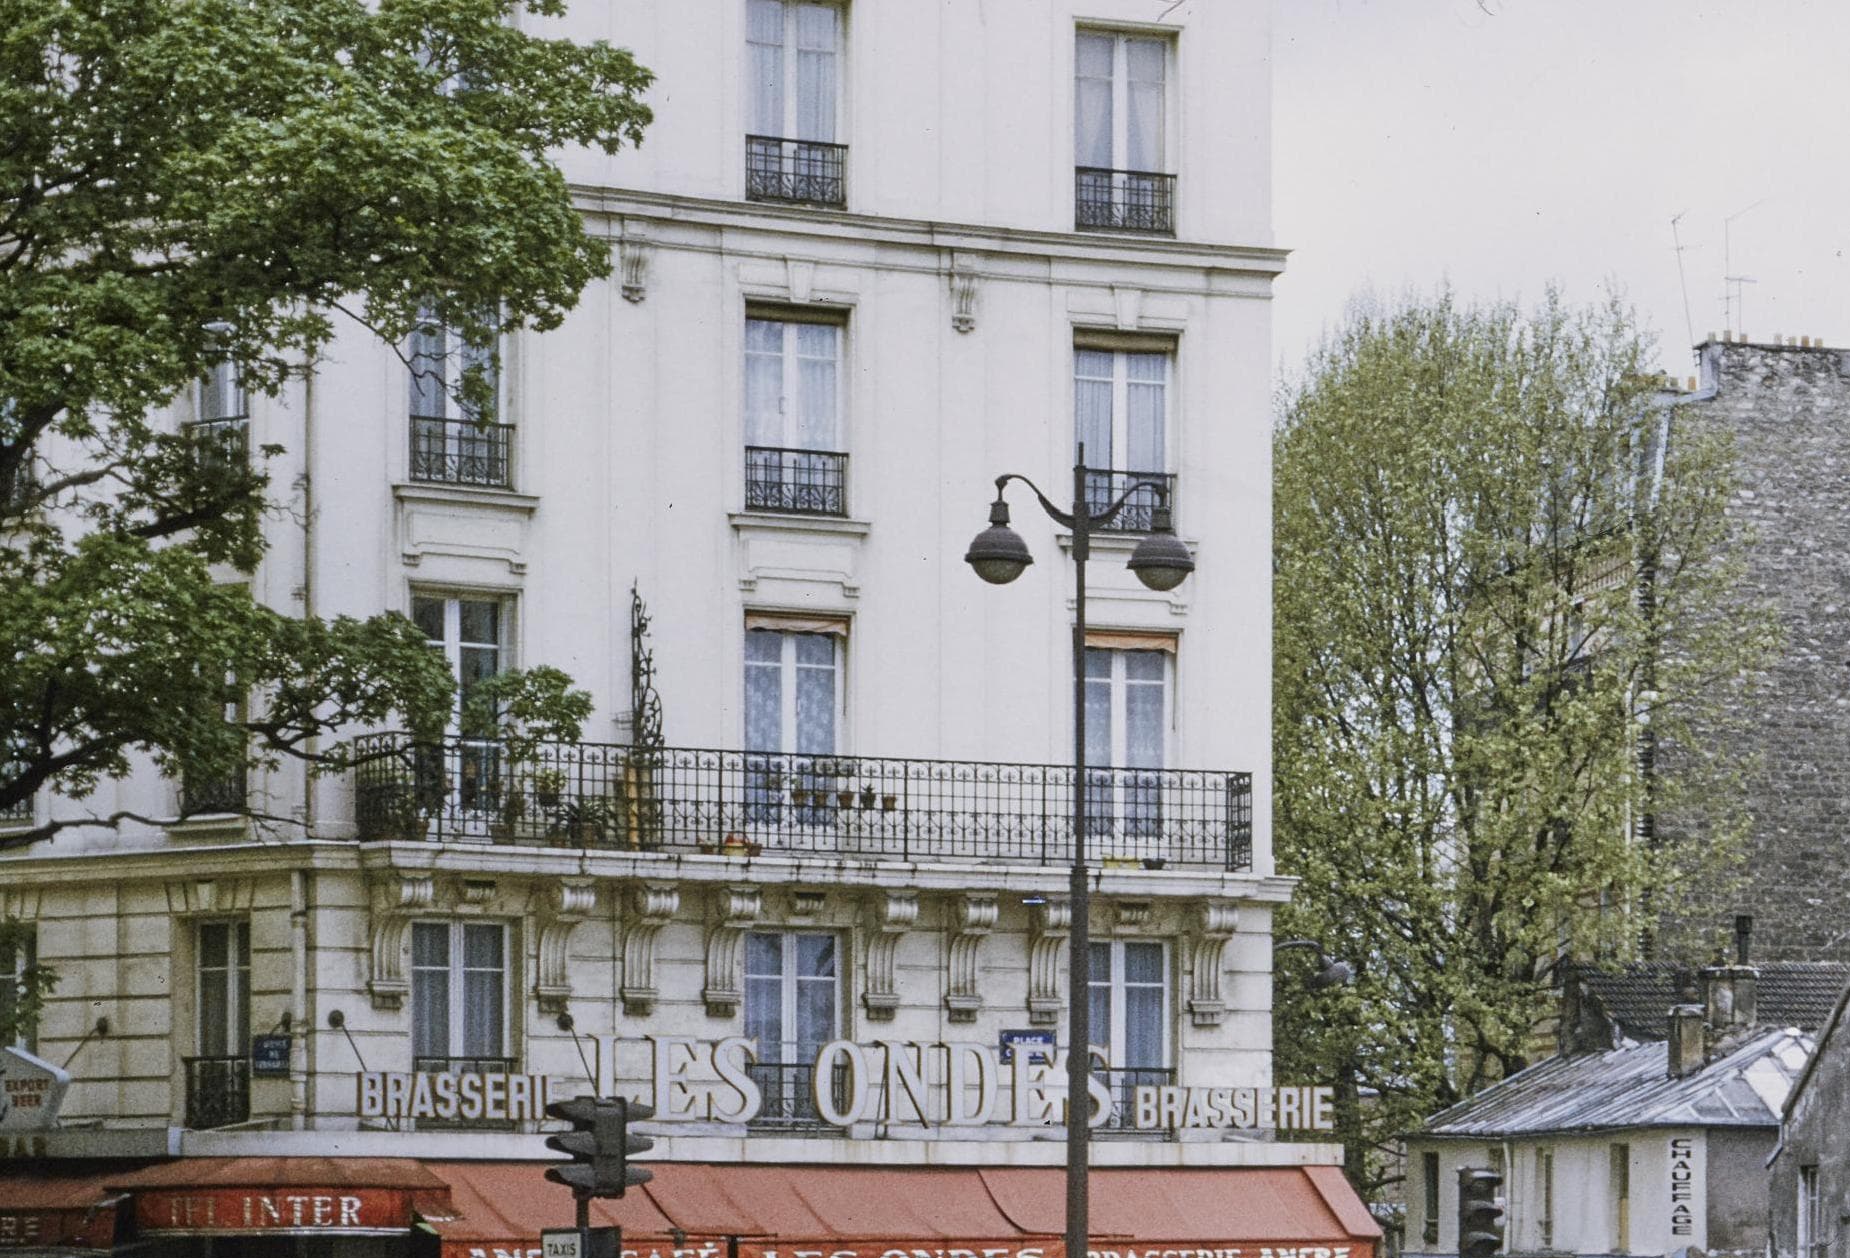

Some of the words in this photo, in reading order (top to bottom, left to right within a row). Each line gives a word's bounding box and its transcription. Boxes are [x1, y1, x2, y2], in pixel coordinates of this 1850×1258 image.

[585, 1034, 763, 1124] LES
[811, 1038, 1112, 1128] ONDES
[1135, 1085, 1335, 1130] BRASSERIE
[1671, 1138, 1693, 1236] CHAUFFAGE
[241, 1196, 363, 1227] INTER
[546, 1243, 577, 1257] TAXIS
